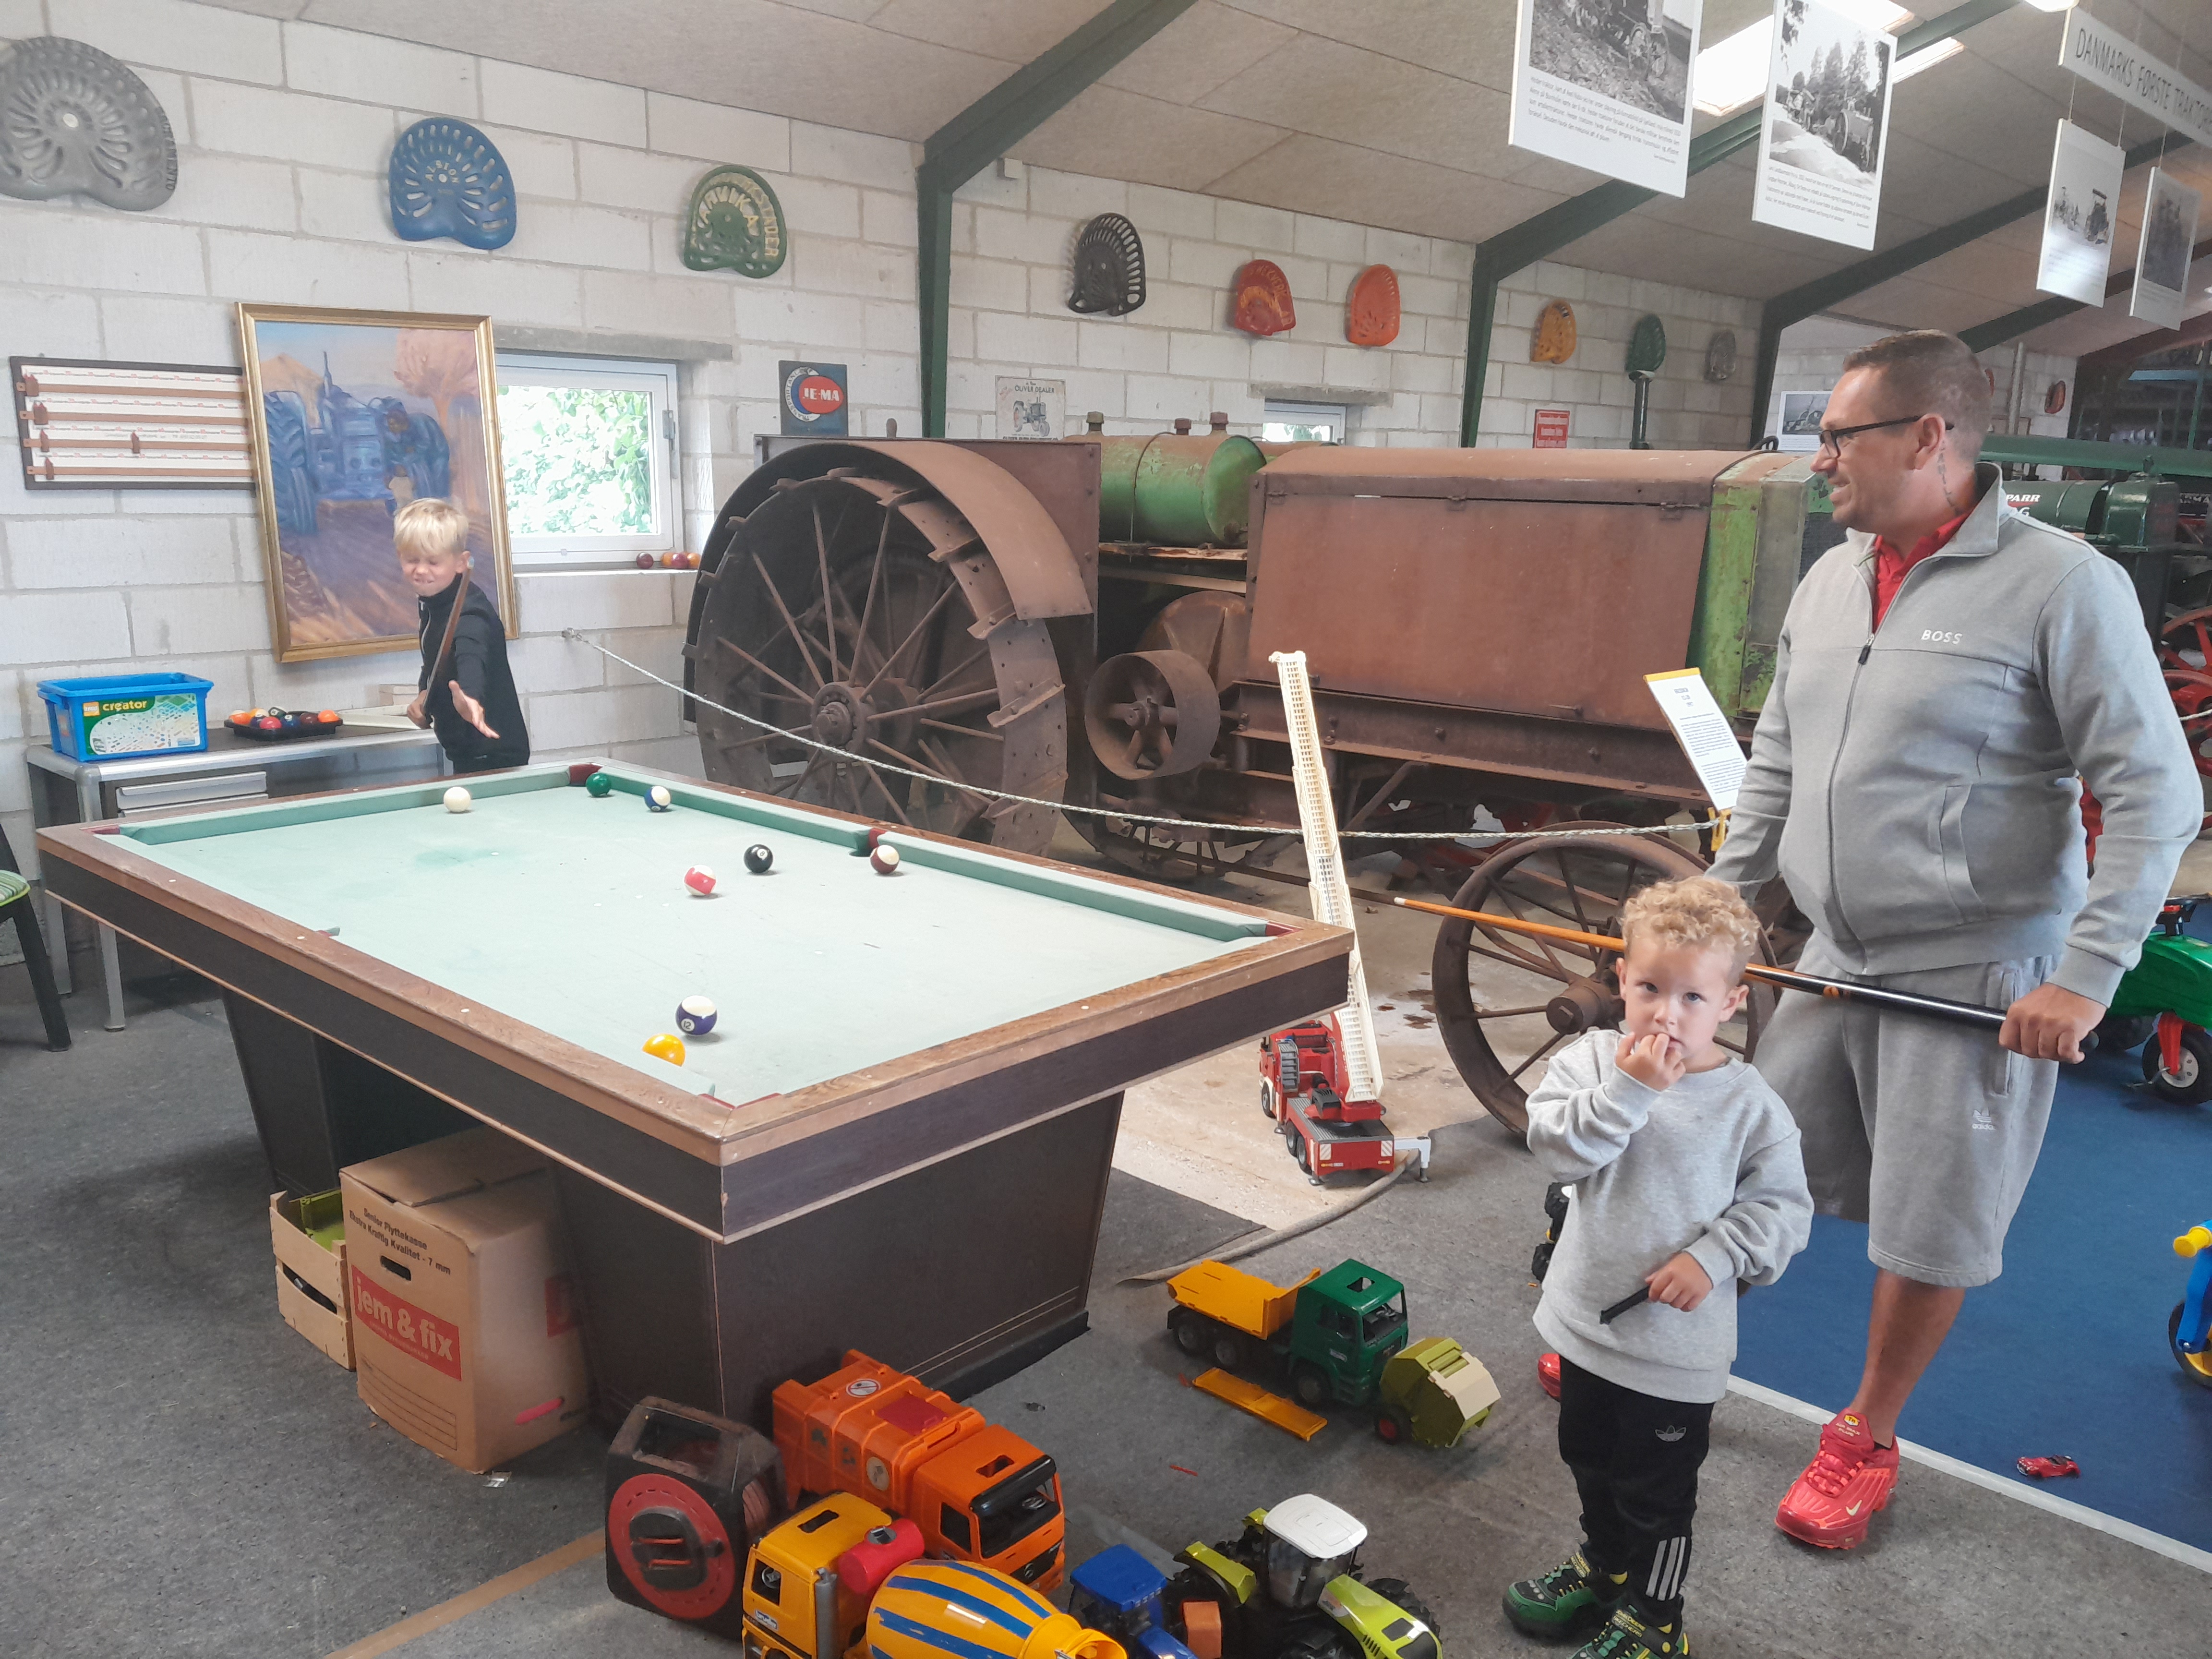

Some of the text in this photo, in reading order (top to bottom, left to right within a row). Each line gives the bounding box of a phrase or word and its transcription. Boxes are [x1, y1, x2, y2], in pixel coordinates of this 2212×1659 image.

[2076, 27, 2135, 87] DANMARKS
[2137, 66, 2172, 110] FØRSTE
[425, 160, 459, 183] ALBION
[698, 185, 760, 228] ARVIKA
[1921, 629, 1963, 644] BOSS
[103, 700, 147, 711] creator
[684, 1021, 691, 1030] 12
[349, 1209, 366, 1230] Ekstra
[368, 1225, 388, 1247] Kraftig
[391, 1239, 420, 1261] Kvalitet
[428, 1257, 433, 1266] 7
[435, 1262, 451, 1275] mm
[363, 1207, 427, 1250] Senior Flyttekasse
[357, 1276, 393, 1330] jem
[397, 1308, 416, 1343] &
[419, 1319, 453, 1361] fix
